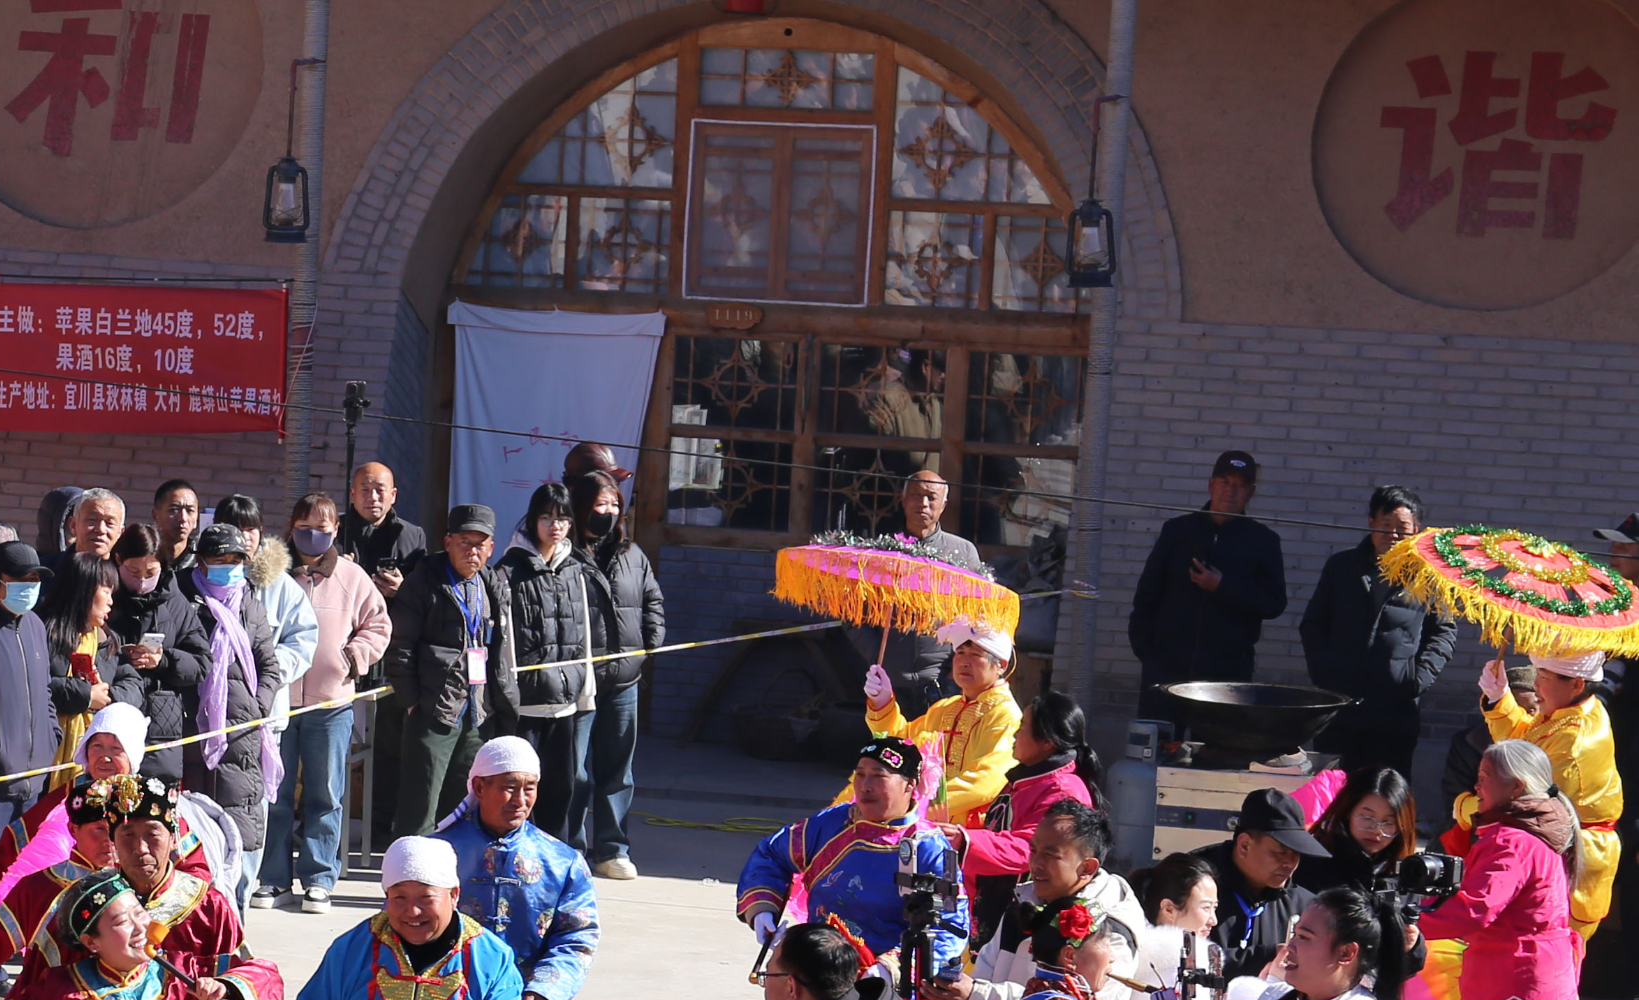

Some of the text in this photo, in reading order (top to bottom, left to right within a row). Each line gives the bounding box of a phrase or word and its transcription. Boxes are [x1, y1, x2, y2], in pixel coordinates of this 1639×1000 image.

[4, 0, 210, 157] 和
[1380, 51, 1617, 240] 谐
[56, 343, 194, 374] 果酒16度，10度
[714, 309, 754, 321] 1119
